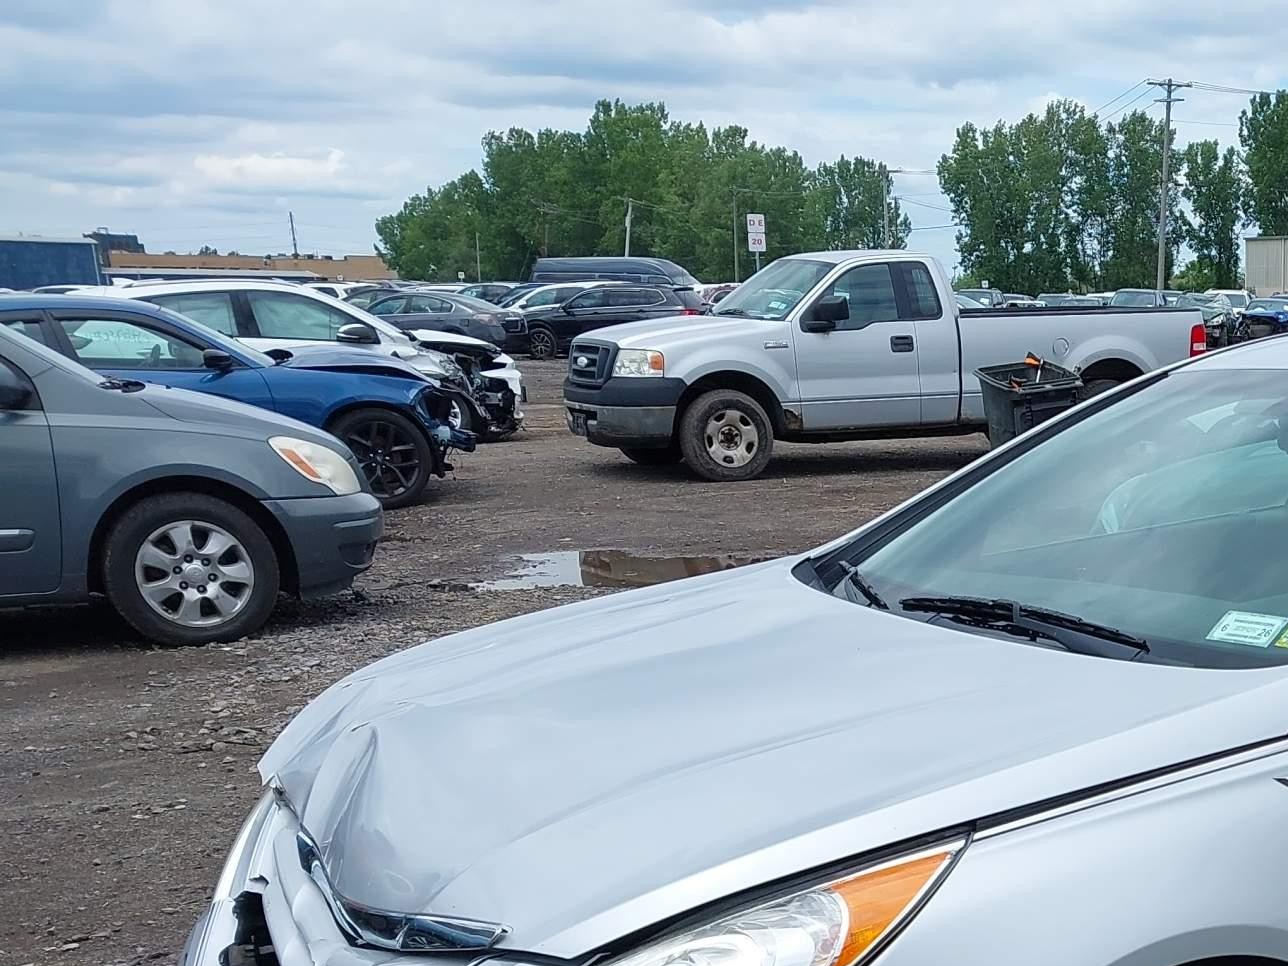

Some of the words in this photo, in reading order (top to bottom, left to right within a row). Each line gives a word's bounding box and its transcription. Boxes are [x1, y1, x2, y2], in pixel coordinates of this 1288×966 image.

[751, 238, 762, 246] 20
[1220, 623, 1230, 632] 6
[1256, 628, 1273, 638] 26
